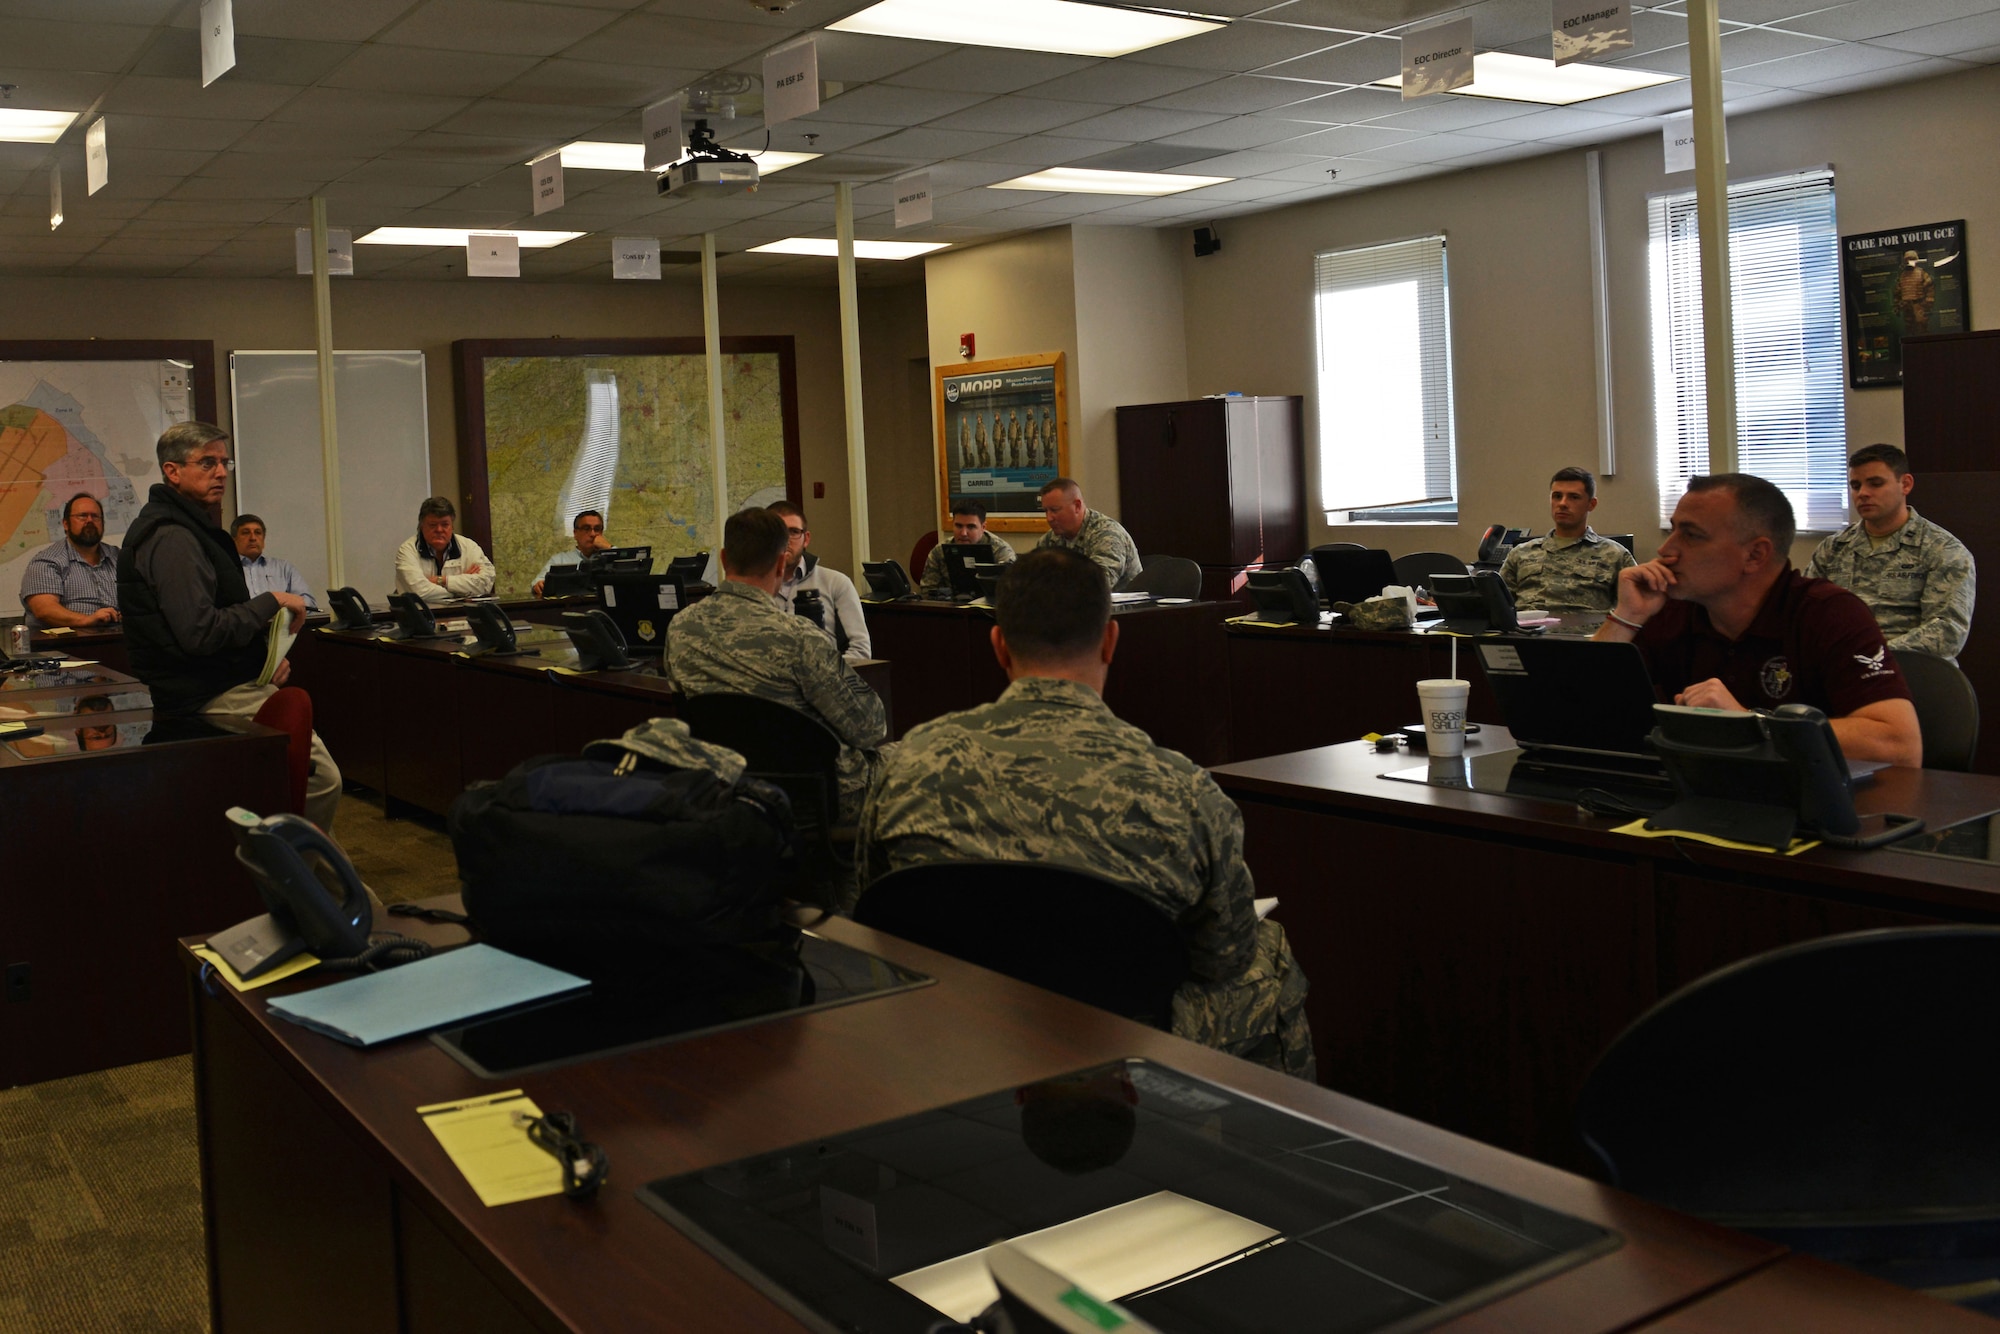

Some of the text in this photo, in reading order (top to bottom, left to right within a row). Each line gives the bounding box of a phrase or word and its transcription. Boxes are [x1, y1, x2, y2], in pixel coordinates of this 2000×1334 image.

[1563, 6, 1619, 29] EOC Manager
[1414, 47, 1462, 65] EOC Director
[776, 71, 804, 89] PA ESF 15
[1674, 138, 1688, 147] EOC
[1849, 227, 1955, 251] CARE FOR YOUR GCE
[960, 379, 1002, 393] MOPP
[967, 479, 994, 487] CARRIED
[1431, 711, 1461, 721] EGGS
[1432, 720, 1461, 730] GRILL
